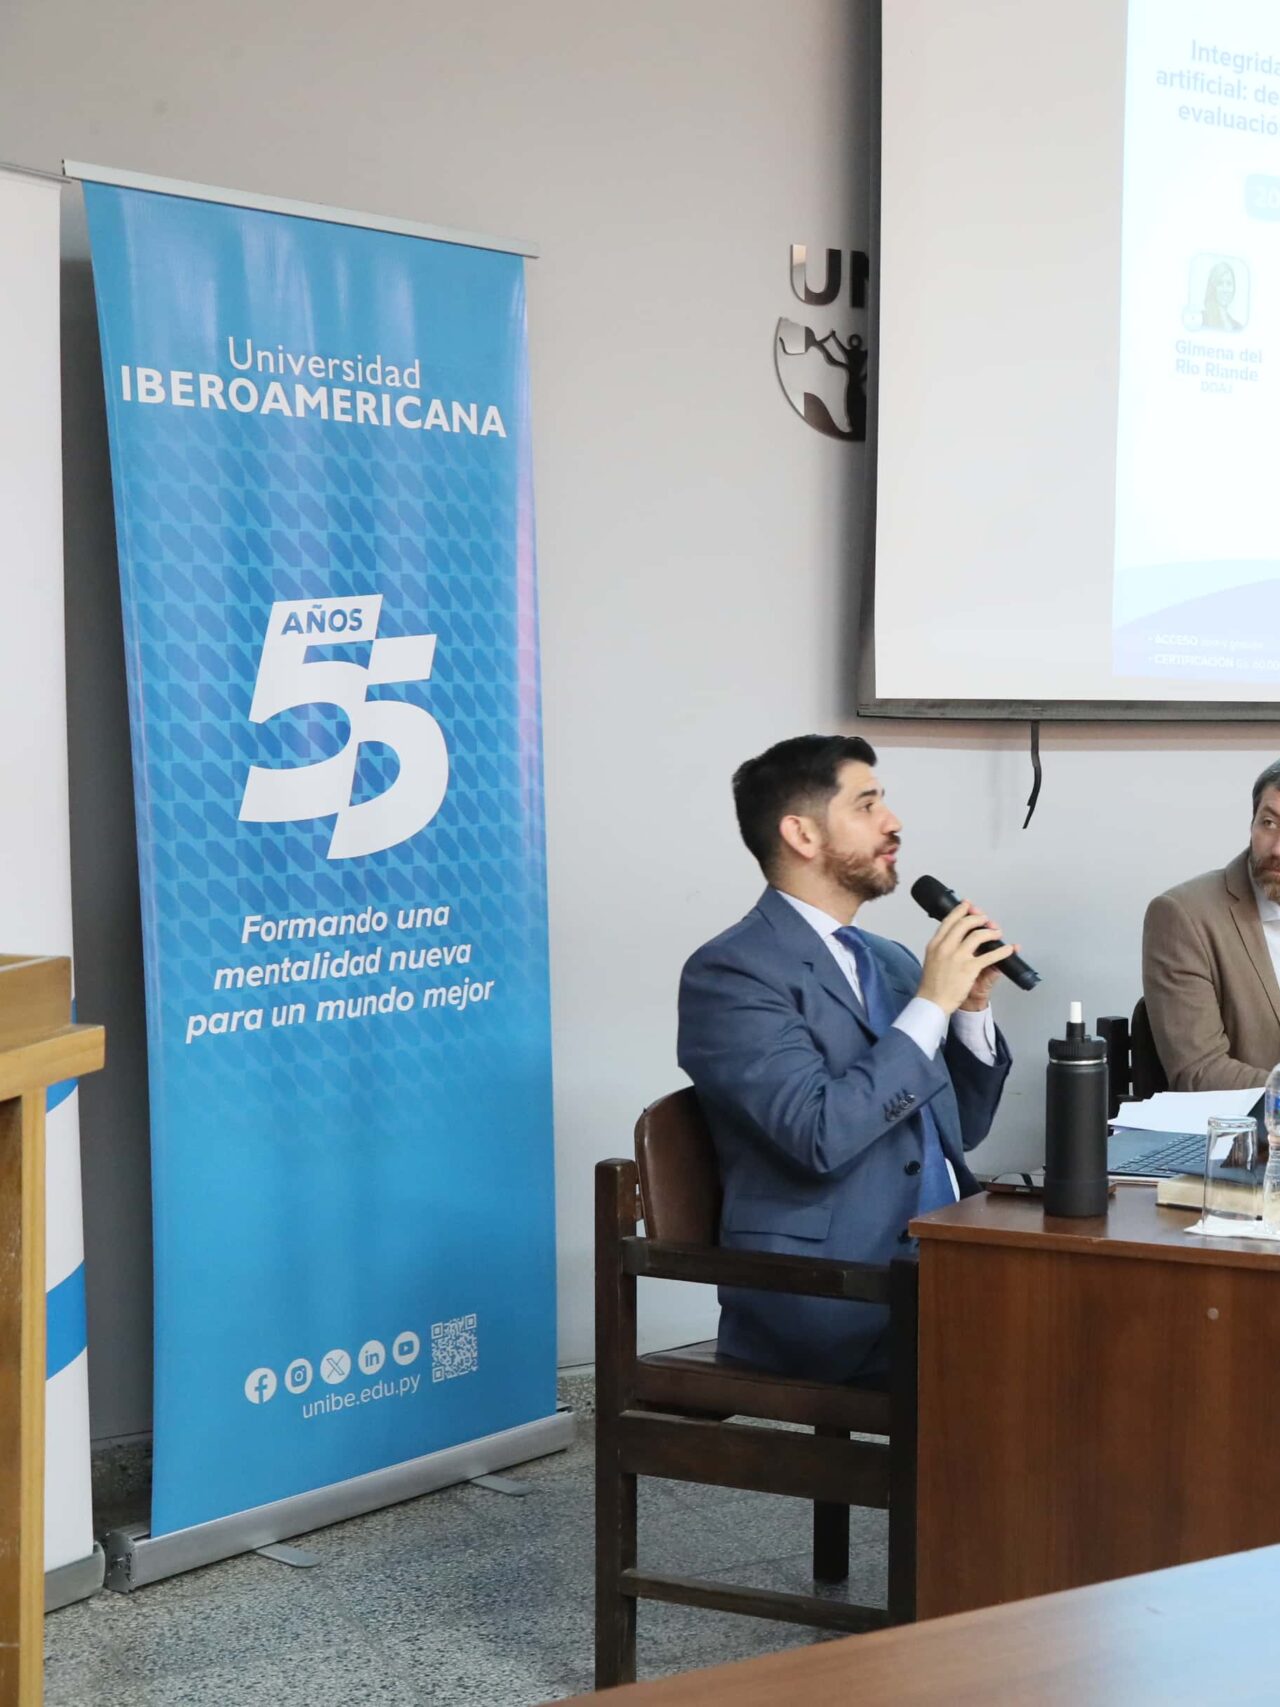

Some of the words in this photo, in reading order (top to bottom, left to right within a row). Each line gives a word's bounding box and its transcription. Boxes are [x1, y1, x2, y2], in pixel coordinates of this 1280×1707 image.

[1155, 67, 1248, 102] artificial:
[227, 335, 421, 390] Universidad
[1175, 339, 1234, 361] Gimena
[119, 364, 507, 438] IBEROAMERICANA
[280, 603, 363, 636] AÑOS
[240, 905, 388, 944] Formando
[396, 904, 450, 930] una
[212, 946, 383, 990] mentalidad
[388, 942, 472, 972] nueva
[184, 1006, 264, 1044] para
[270, 1002, 306, 1028] un
[315, 985, 415, 1022] mundo
[422, 976, 495, 1012] mejor
[302, 1373, 421, 1419] unibe.edu.py
